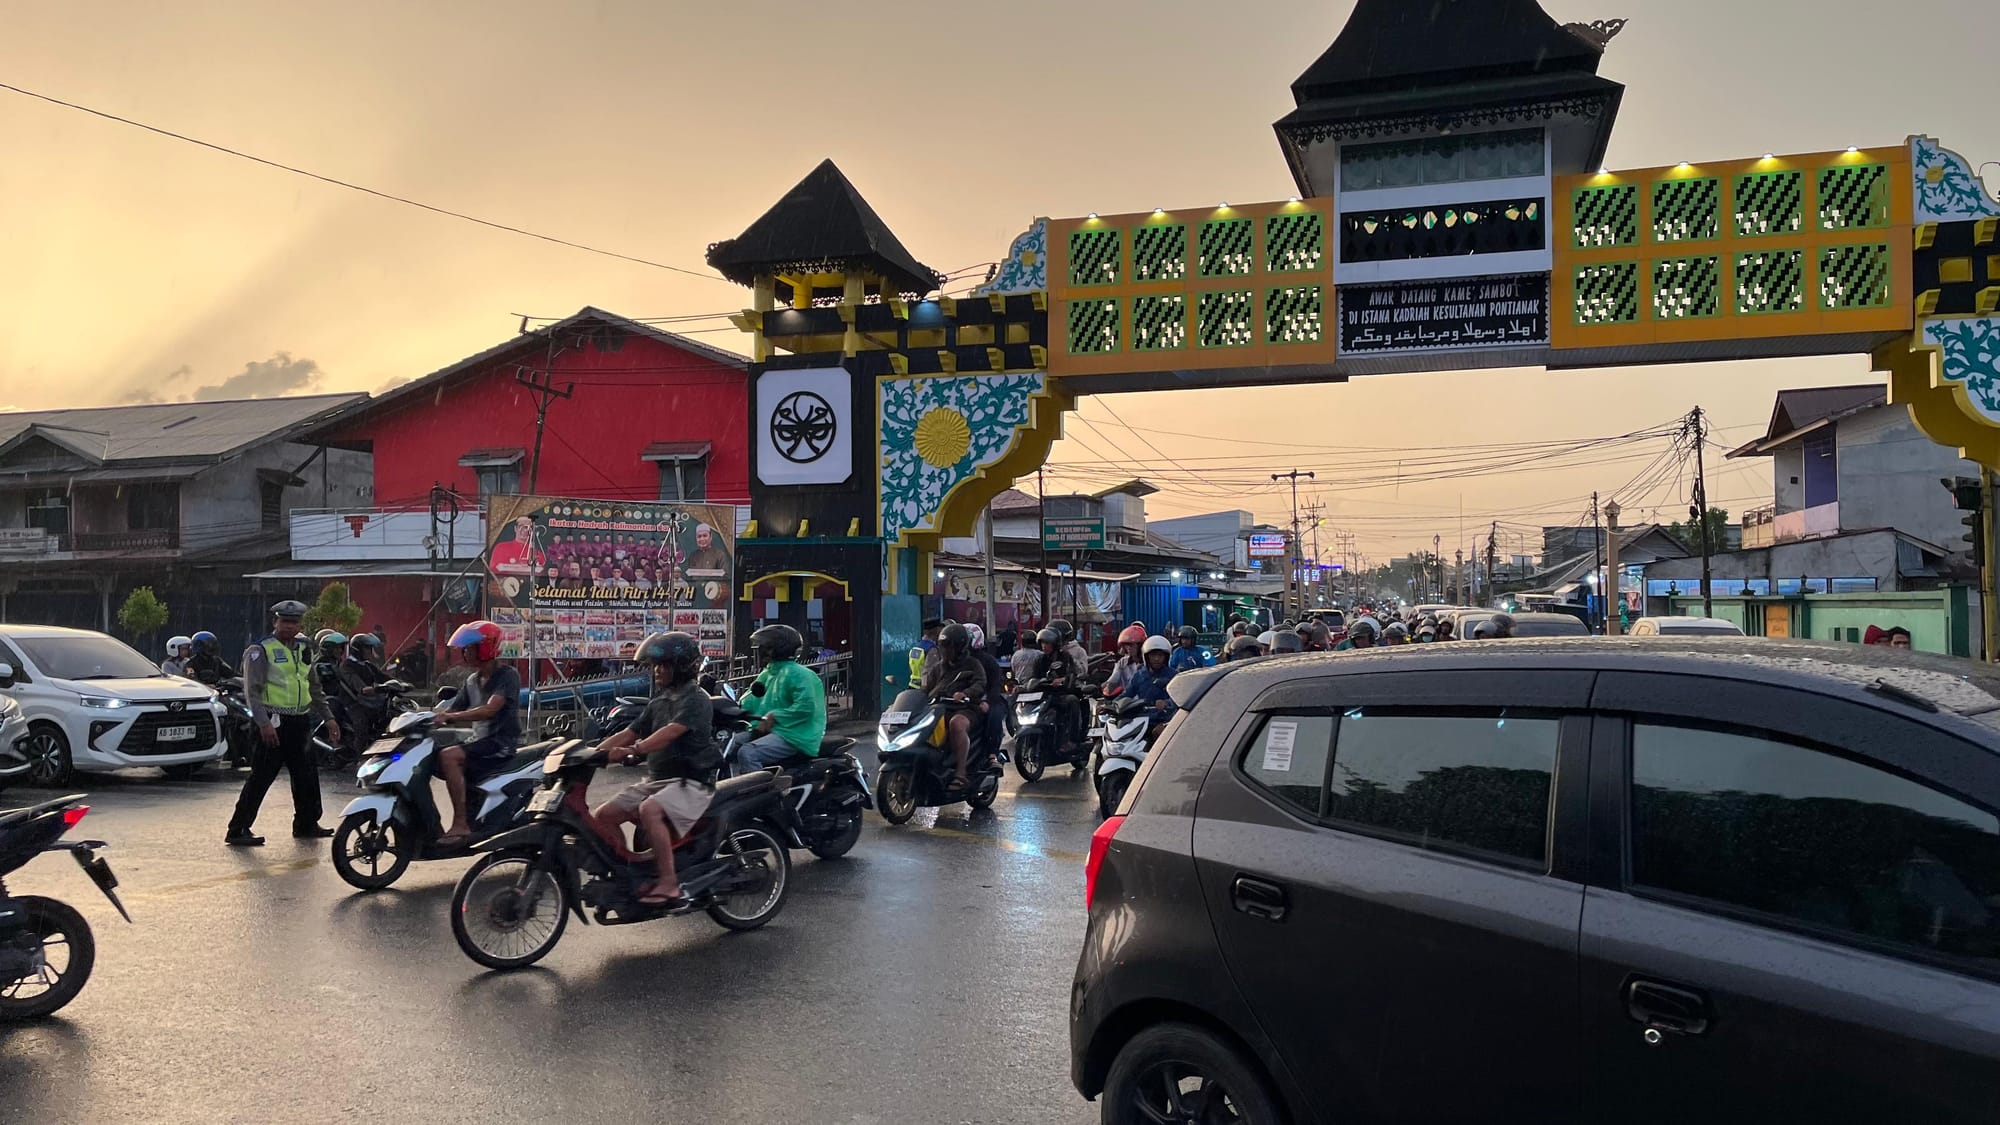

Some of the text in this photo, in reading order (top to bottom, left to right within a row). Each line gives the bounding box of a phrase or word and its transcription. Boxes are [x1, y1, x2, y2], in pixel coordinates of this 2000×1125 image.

[1369, 289, 1394, 306] AWAK
[1401, 287, 1437, 304] DATANG
[1348, 299, 1539, 325] DI ISTANA KADRIAH KESULTANAN PONTIANAK
[549, 518, 576, 527] Ikatan
[609, 522, 656, 531] Kalimantan
[529, 583, 587, 598] Selamat
[590, 585, 619, 599] Idul
[623, 586, 650, 599] Fitri
